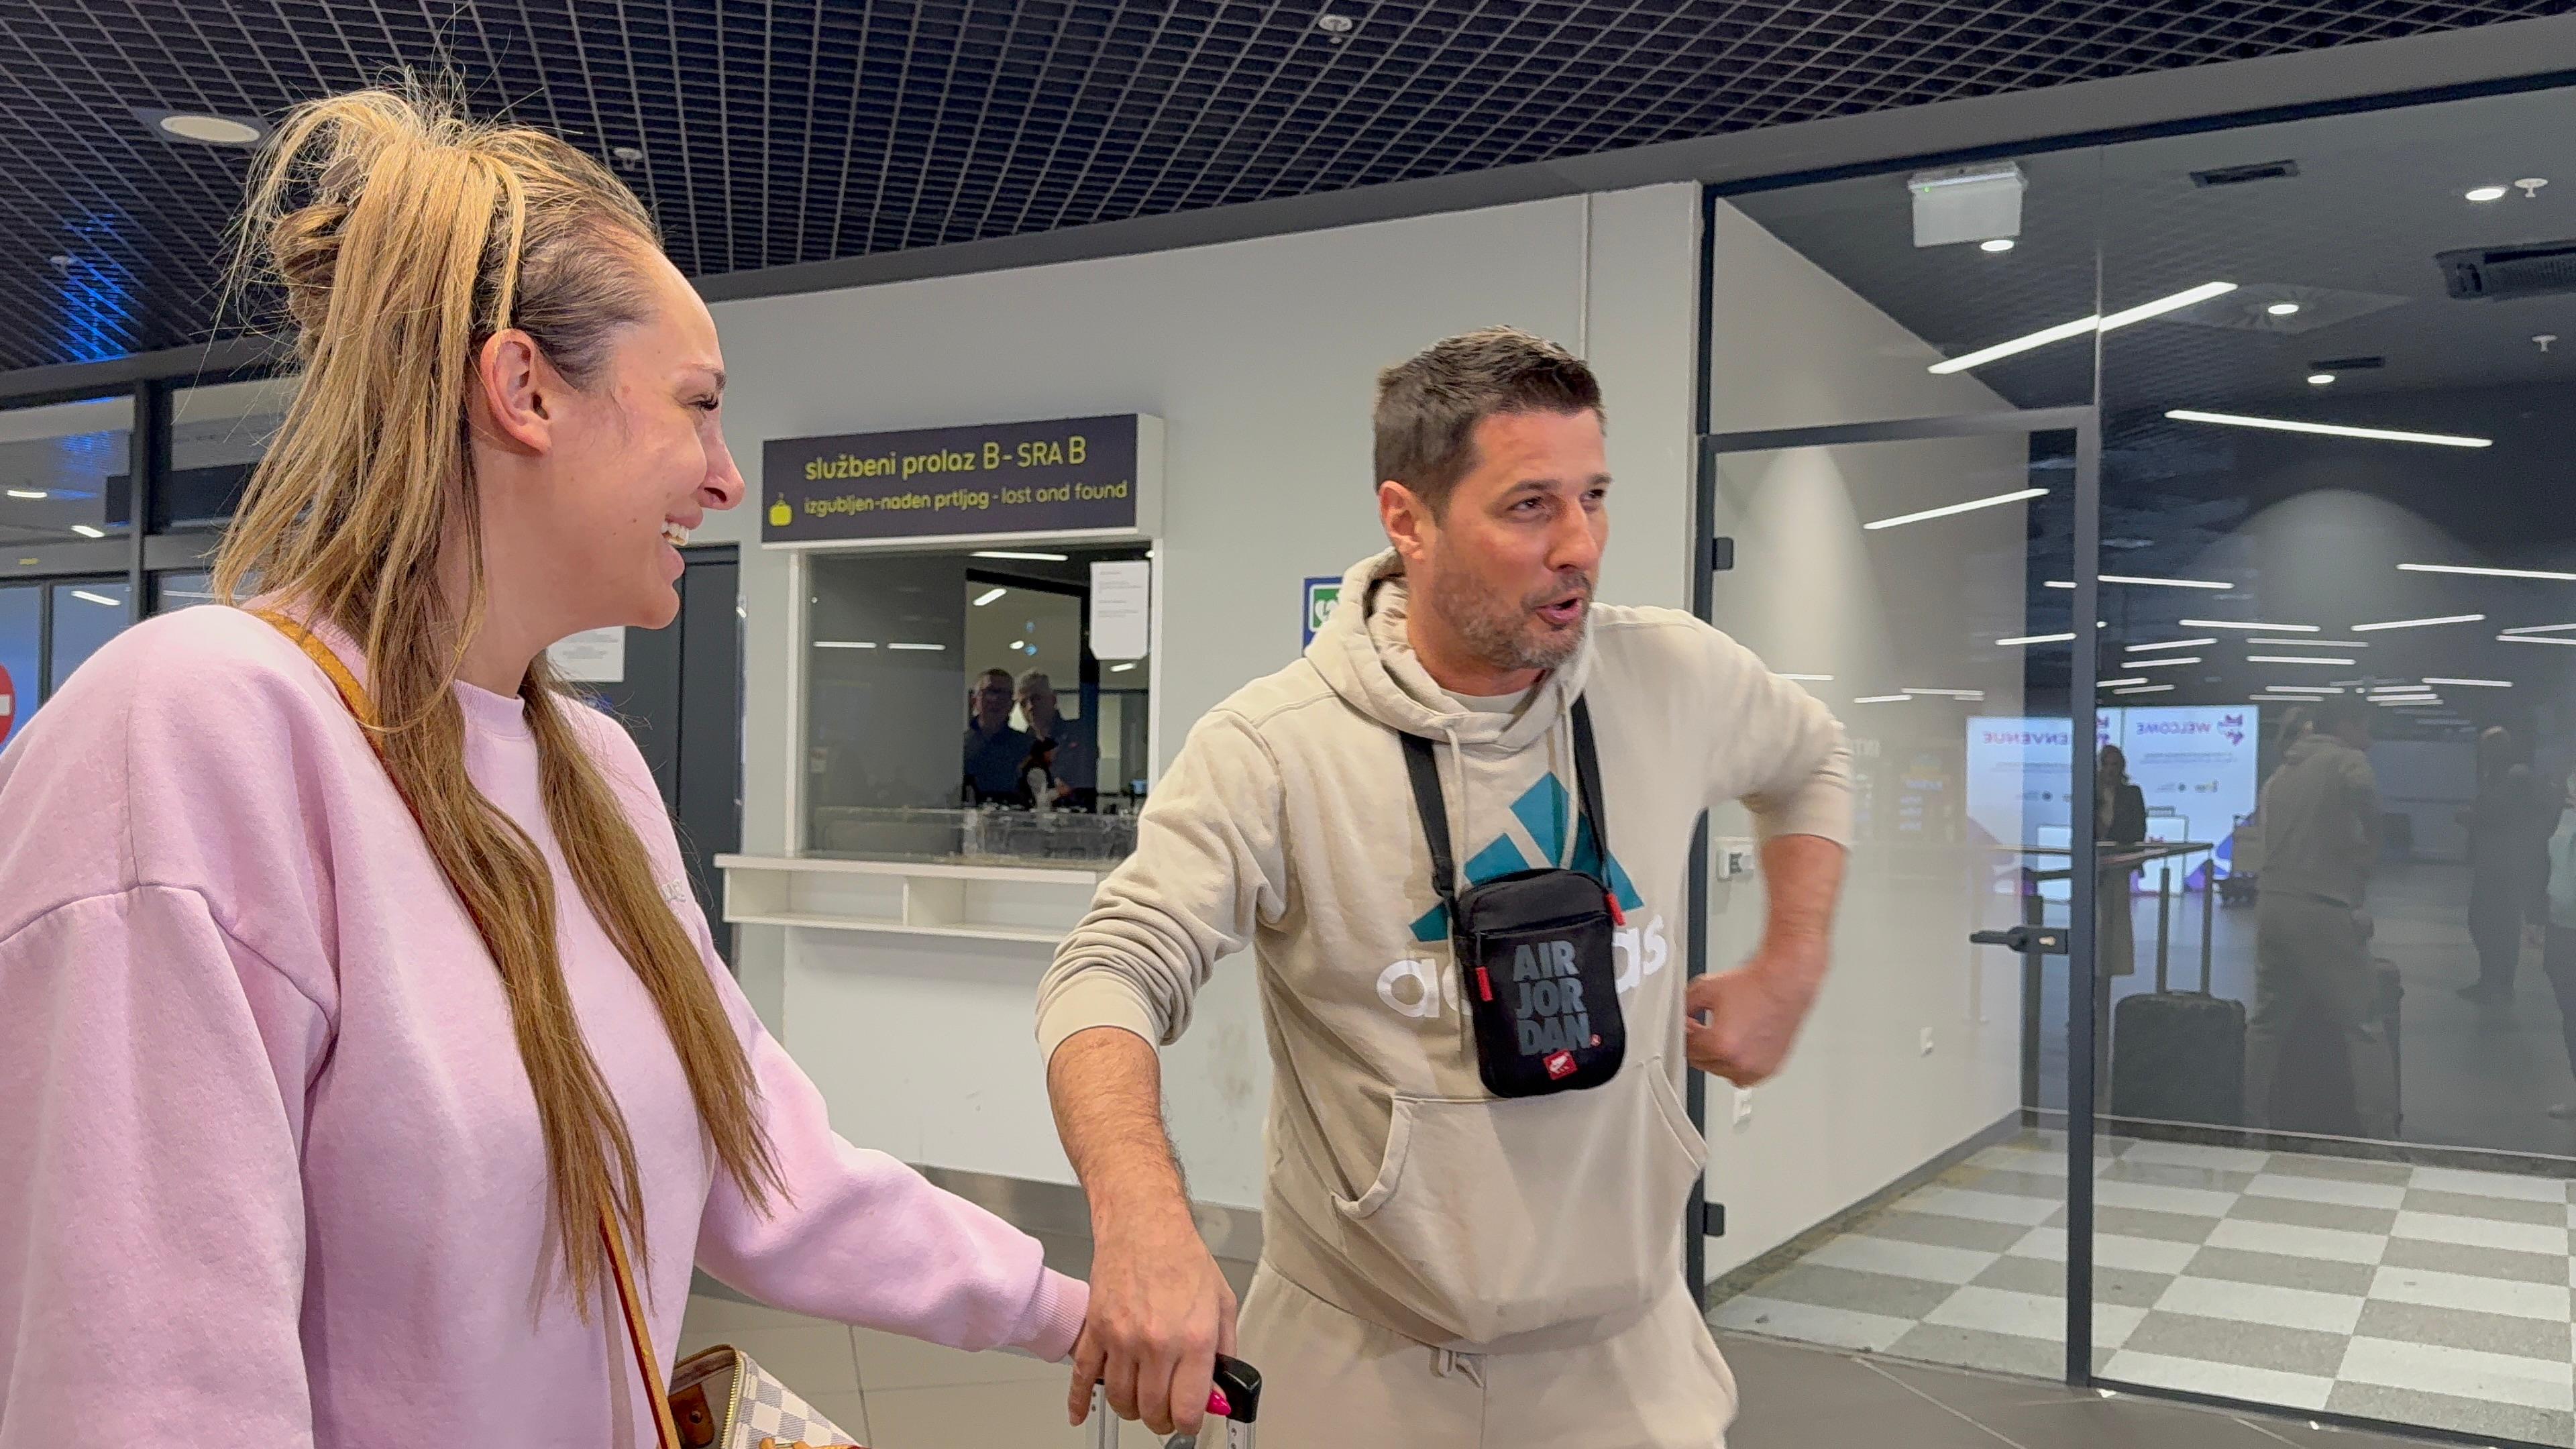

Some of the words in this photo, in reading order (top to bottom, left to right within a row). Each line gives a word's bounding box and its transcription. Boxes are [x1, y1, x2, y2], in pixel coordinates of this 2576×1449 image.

[805, 450, 896, 480] službeni
[902, 448, 976, 481] prolaz
[1016, 440, 1063, 468] SRA
[1068, 435, 1087, 464] B
[934, 488, 989, 511] prtljag
[1001, 485, 1032, 504] lost
[1036, 482, 1071, 502] and
[1075, 479, 1128, 500] found
[1376, 914, 1668, 1019] aas
[1513, 940, 1580, 982] AIR
[1515, 977, 1587, 1020] JOR
